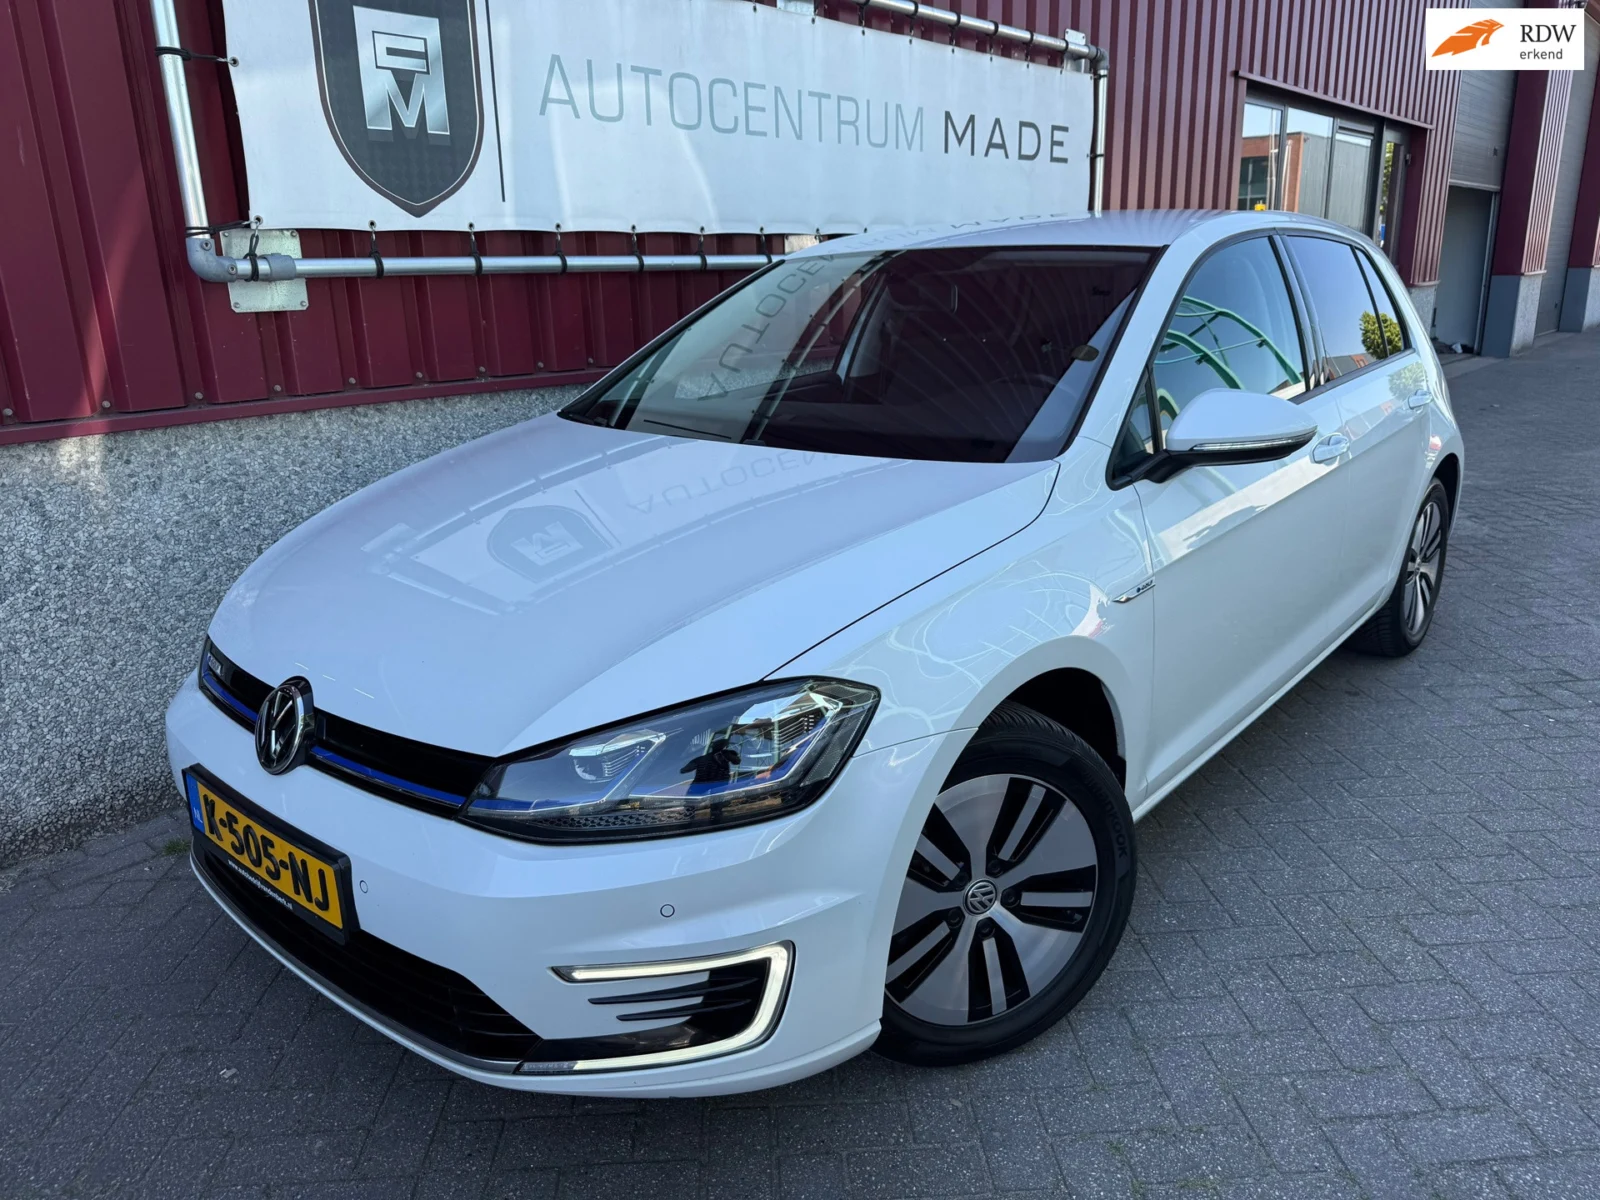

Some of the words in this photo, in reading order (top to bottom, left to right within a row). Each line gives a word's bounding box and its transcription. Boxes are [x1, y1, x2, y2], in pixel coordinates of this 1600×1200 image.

[538, 53, 924, 153] AUTOCENTRUM
[943, 110, 1070, 164] MADE
[203, 793, 330, 912] K-505-NJ
